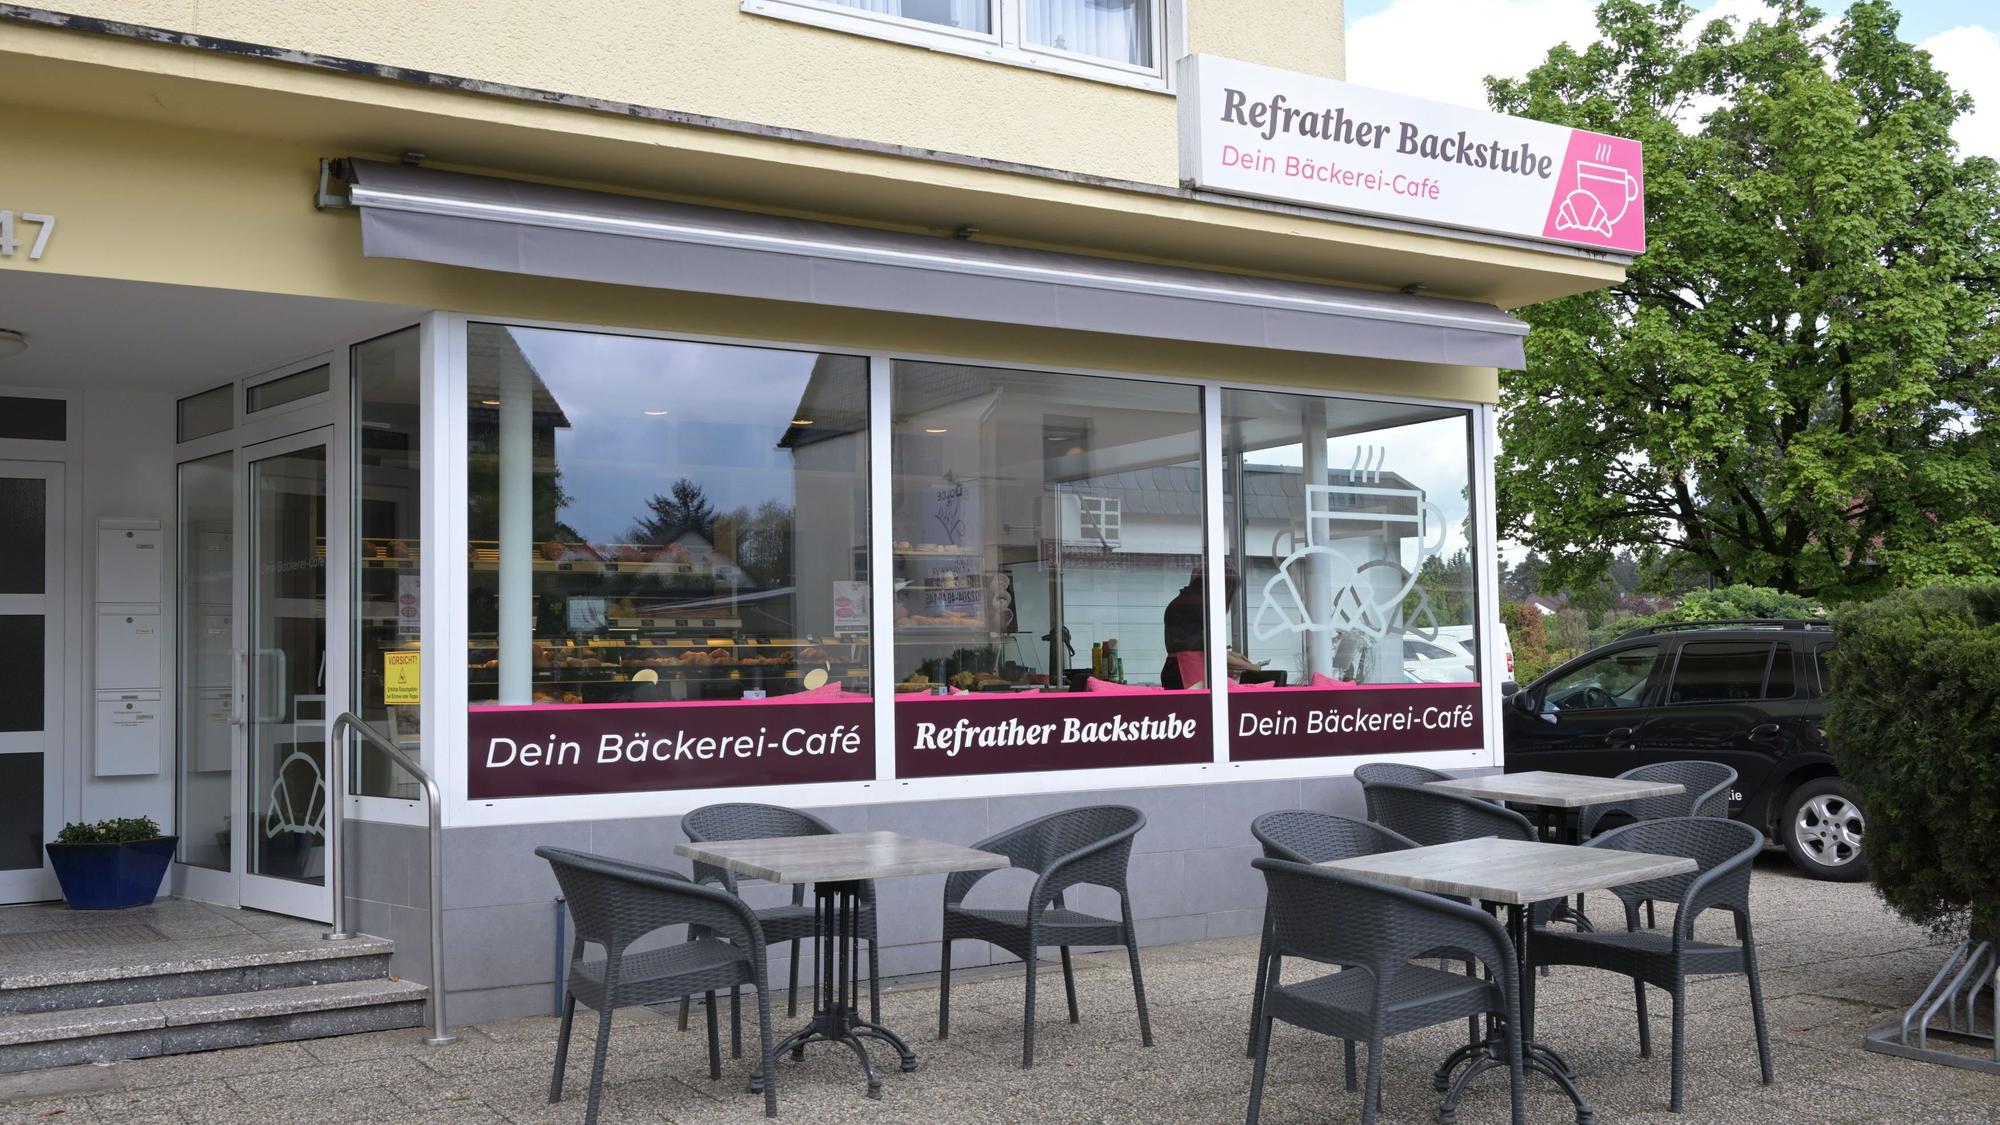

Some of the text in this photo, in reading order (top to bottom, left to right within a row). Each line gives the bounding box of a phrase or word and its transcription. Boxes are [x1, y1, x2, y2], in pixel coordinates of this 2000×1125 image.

[1221, 88, 1552, 179] Refrather Backstube
[1221, 144, 1441, 201] Dein Bäckerei-Café
[388, 655, 418, 665] VORSICHT!
[914, 712, 1197, 757] Refrather Backstube
[1239, 704, 1474, 737] Dein Bäckerei-Café
[485, 724, 861, 768] Dein Bäckerei-Café
